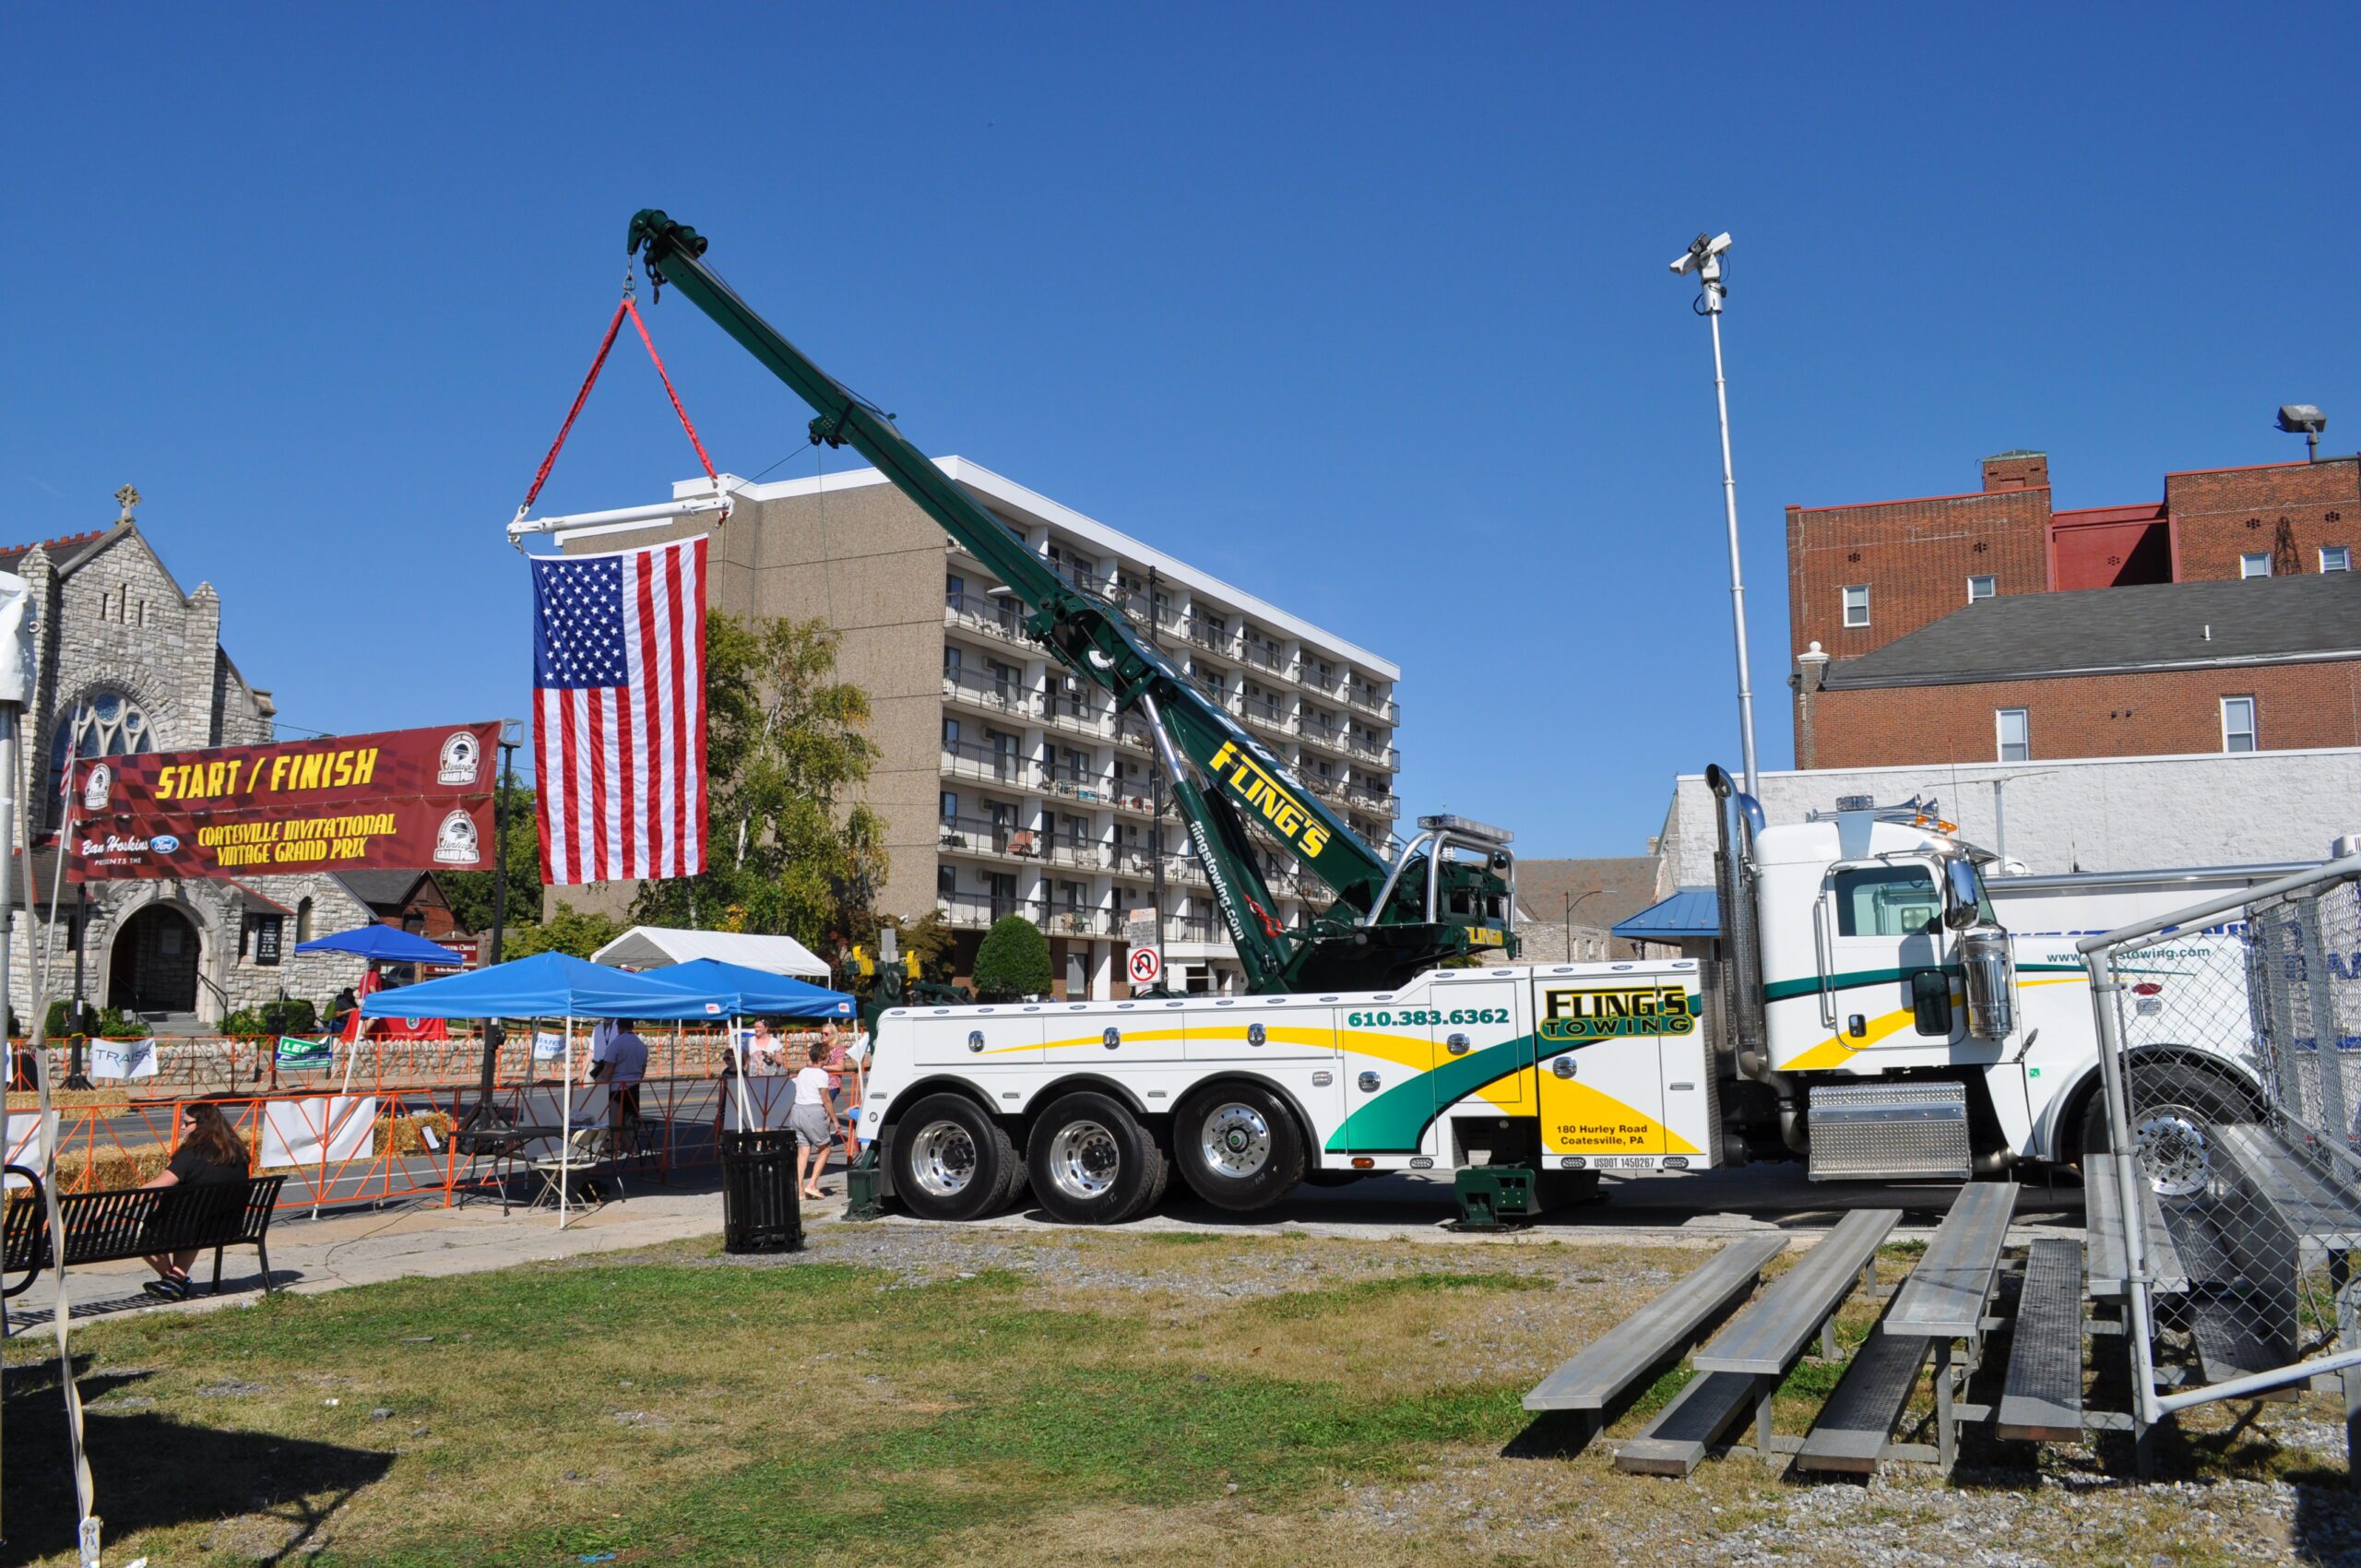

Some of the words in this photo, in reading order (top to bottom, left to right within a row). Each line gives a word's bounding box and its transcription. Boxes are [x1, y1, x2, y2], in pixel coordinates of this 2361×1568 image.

[155, 759, 242, 800] START
[246, 757, 266, 793] /
[270, 748, 378, 791] FINISH
[1209, 741, 1332, 859] FLING'S
[197, 821, 282, 846] COATESVILLE
[283, 814, 397, 840] INVITATIONAL
[106, 835, 149, 852] Hoskins
[217, 843, 270, 866] VINTAGE
[274, 838, 328, 862] GRAND
[329, 837, 368, 860] PRIX
[1190, 820, 1245, 942] flingstowing.com
[1546, 985, 1688, 1019] FLING'S
[1347, 1008, 1510, 1028] 610.383.6362
[1546, 1017, 1690, 1035] TOWING
[1557, 1125, 1576, 1134] 180
[1579, 1124, 1616, 1135] Hurley
[1619, 1124, 1647, 1134] Road
[1560, 1135, 1626, 1146] Coatesville,
[1630, 1135, 1644, 1145] PA
[1594, 1158, 1618, 1168] USDOT
[1620, 1158, 1655, 1168] 1450267
